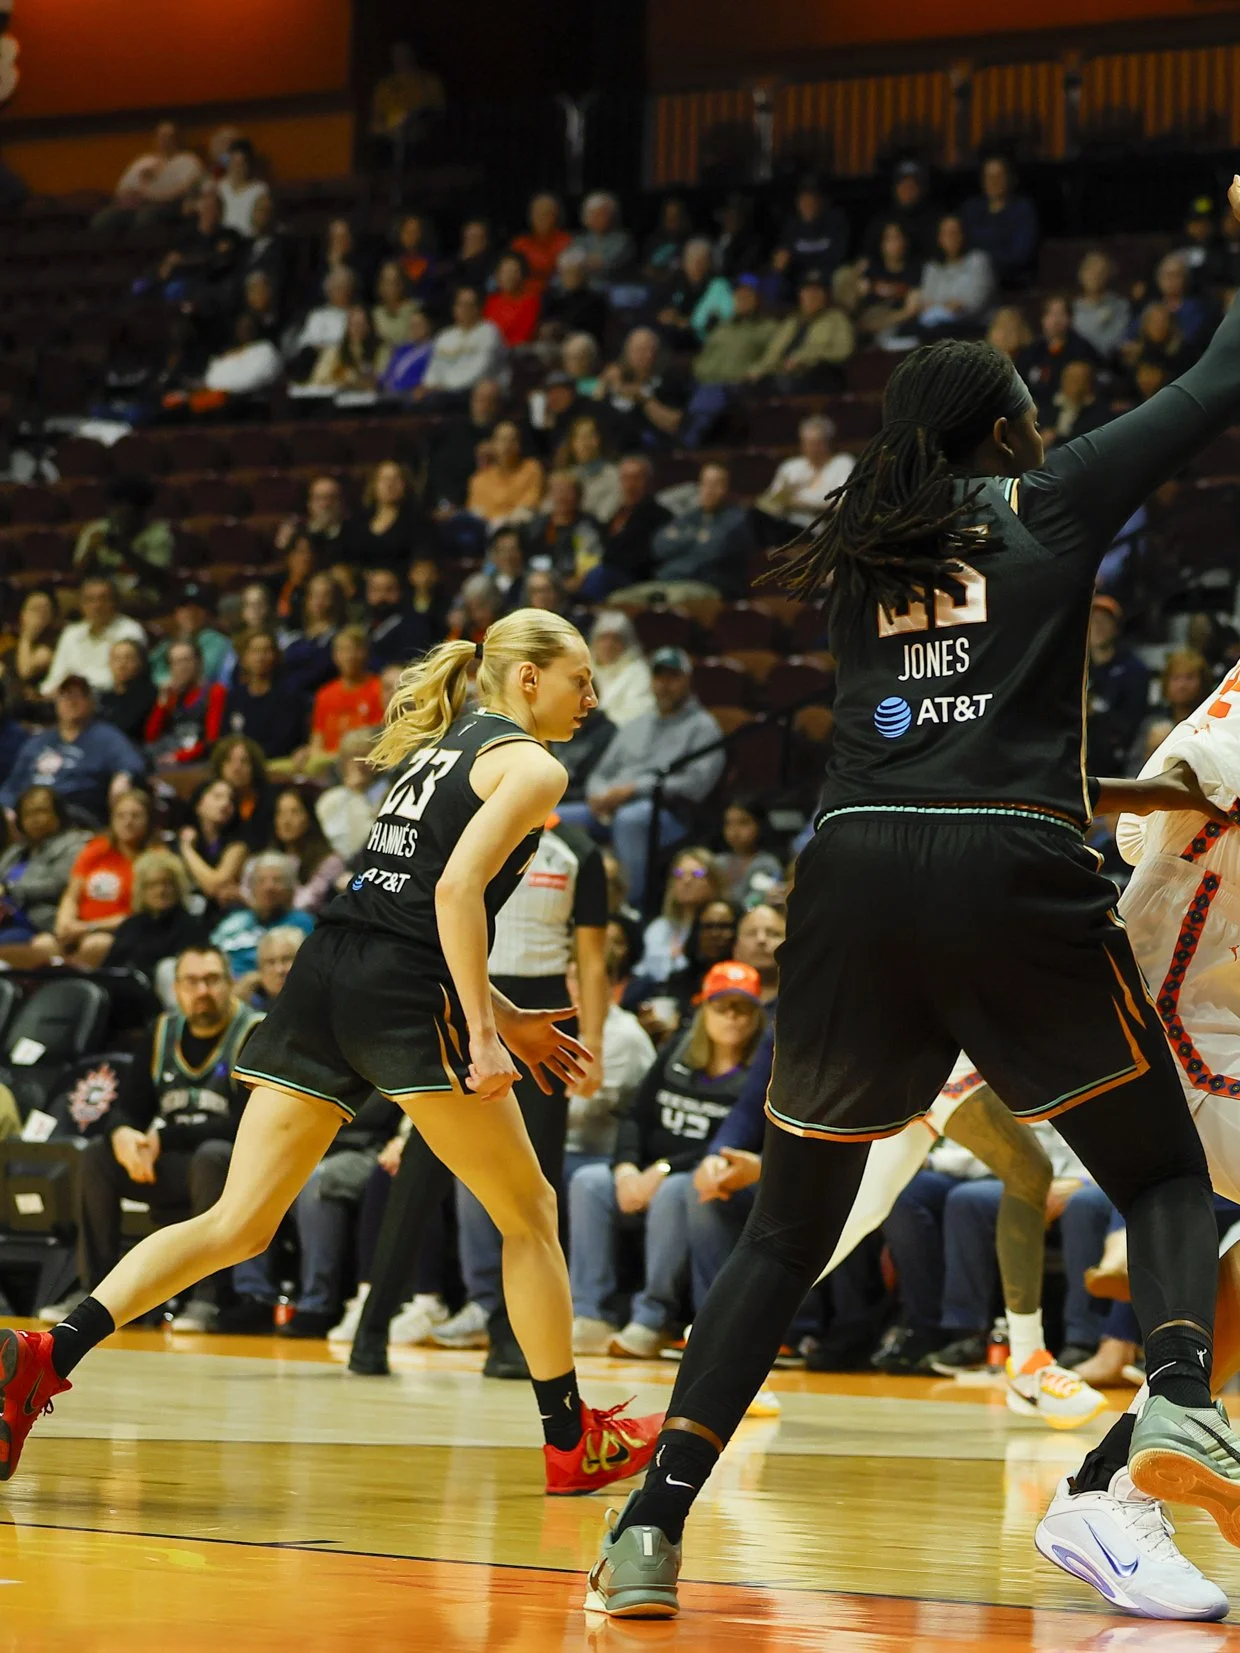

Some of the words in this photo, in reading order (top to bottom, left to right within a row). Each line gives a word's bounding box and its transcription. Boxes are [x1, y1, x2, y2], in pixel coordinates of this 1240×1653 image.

[897, 637, 970, 682] JONES
[916, 693, 993, 726] AT&T
[378, 748, 463, 821] 23
[361, 867, 411, 893] AT&T
